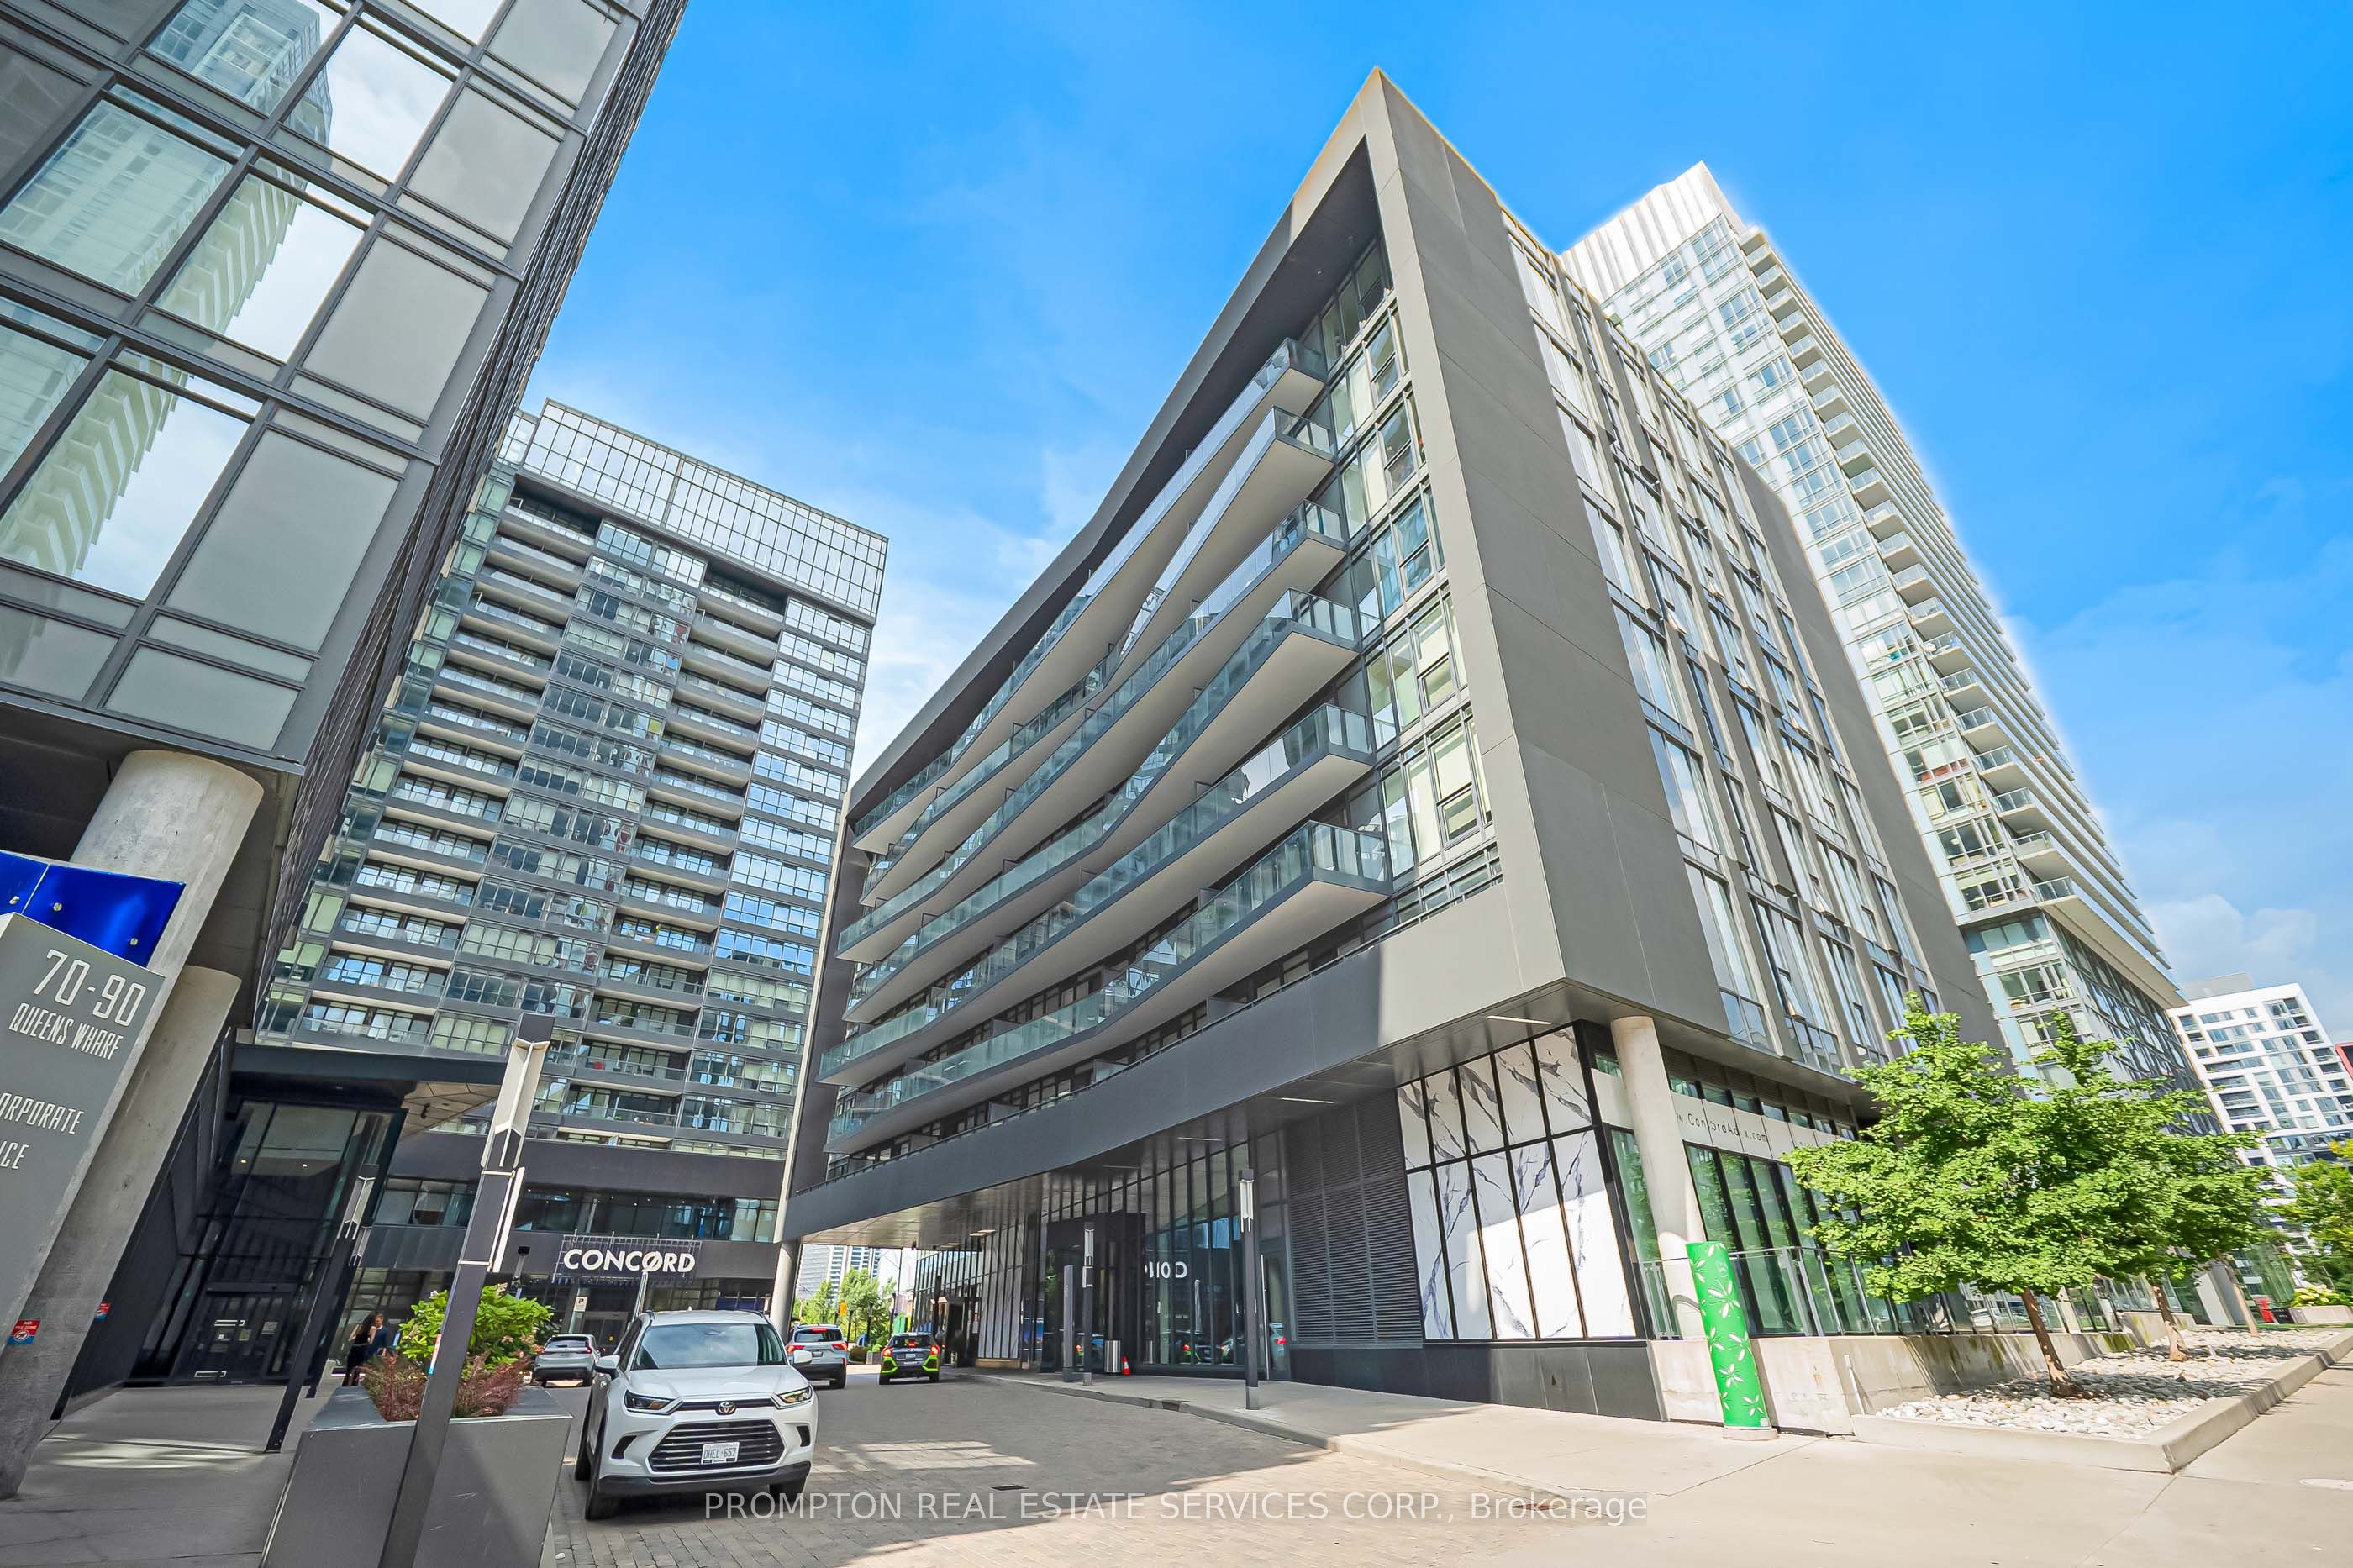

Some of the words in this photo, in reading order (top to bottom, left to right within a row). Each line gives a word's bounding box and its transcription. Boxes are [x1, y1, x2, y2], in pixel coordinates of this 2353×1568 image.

[33, 949, 146, 1027] 70-90
[9, 1002, 74, 1045] QUEENS
[71, 1022, 124, 1060] WHARF
[724, 1447, 736, 1457] 657
